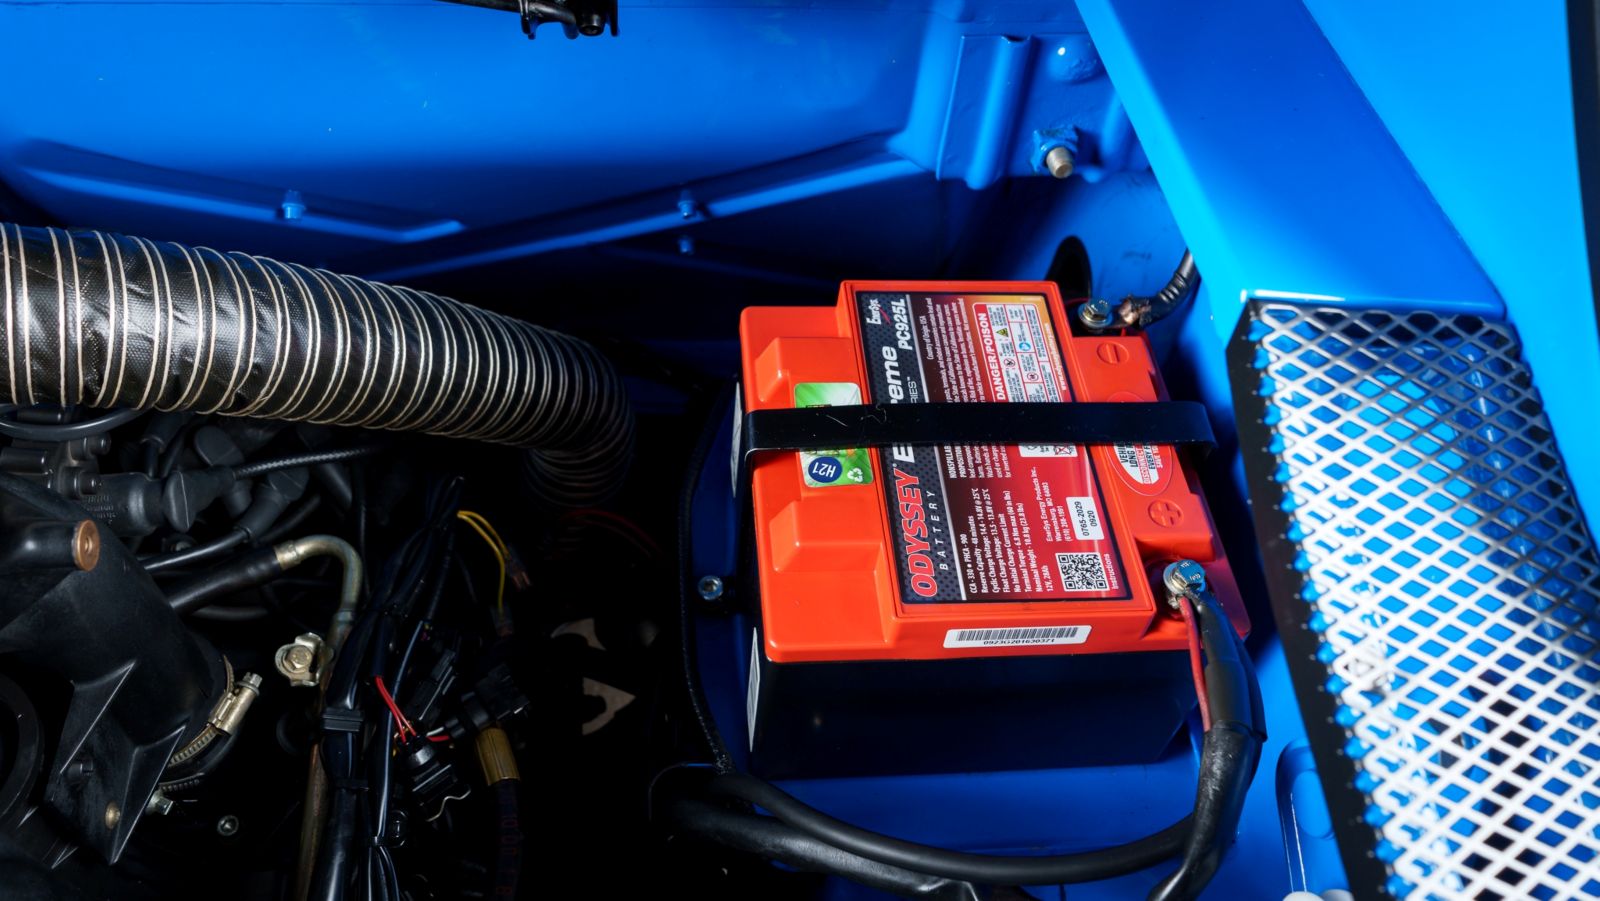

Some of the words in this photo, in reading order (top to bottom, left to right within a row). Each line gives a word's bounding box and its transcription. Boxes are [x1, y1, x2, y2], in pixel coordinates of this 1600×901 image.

[890, 298, 913, 350] PC925L
[919, 315, 927, 324] USA
[921, 324, 930, 337] Origin:
[924, 344, 934, 359] Country
[977, 312, 1006, 400] DANGER/POISON
[944, 445, 956, 478] NONSPILLAB
[963, 446, 975, 467] compound
[972, 446, 982, 463] Batterie
[1127, 451, 1138, 467] LONG
[1146, 451, 1155, 469] EVERY
[812, 462, 836, 478] H21
[1136, 448, 1149, 483] DISCONNECT
[1003, 490, 1011, 499] lbs)
[1032, 477, 1043, 500] Products
[1016, 502, 1024, 511] lbs)
[1037, 501, 1049, 518] Energy
[1045, 497, 1053, 506] MO
[975, 505, 984, 519] 14.8V
[985, 505, 994, 519] 13.8V
[1006, 506, 1015, 514] (60
[1087, 510, 1097, 526] 0920
[967, 515, 977, 536] minutes
[998, 513, 1006, 526] Limit
[1009, 515, 1017, 526] max
[1018, 512, 1028, 525] (23.8
[1048, 507, 1063, 541] Warrensburg,
[1073, 501, 1090, 536] 0765-2029
[926, 491, 948, 569] BATTERY
[979, 523, 987, 534] 14.4
[989, 524, 997, 534] 13.5
[1001, 527, 1011, 546] Current
[1011, 527, 1019, 536] Nm
[1042, 520, 1054, 541] EnerSys
[960, 534, 968, 543] 900
[1023, 532, 1031, 544] 10.8
[963, 547, 971, 562] PHCA
[981, 535, 993, 558] Voltage:
[992, 536, 1003, 558] Voltage:
[973, 548, 985, 570] Capacity
[1005, 547, 1017, 566] Charge
[1016, 549, 1027, 567] Torque
[1027, 549, 1038, 567] Weight
[986, 558, 997, 577] Charge
[997, 558, 1008, 577] Charge
[1009, 567, 1019, 583] Initial
[1041, 565, 1050, 578] 28Ah
[1102, 553, 1119, 589] Instructions
[969, 582, 977, 592] CCA
[978, 571, 988, 592] Reserve
[990, 578, 1000, 592] Cyclic
[1001, 578, 1010, 592] Float
[1020, 568, 1031, 591] Terminal
[1031, 568, 1042, 591] Nominal
[1044, 579, 1054, 591] 12V,
[1013, 584, 1021, 592] No
